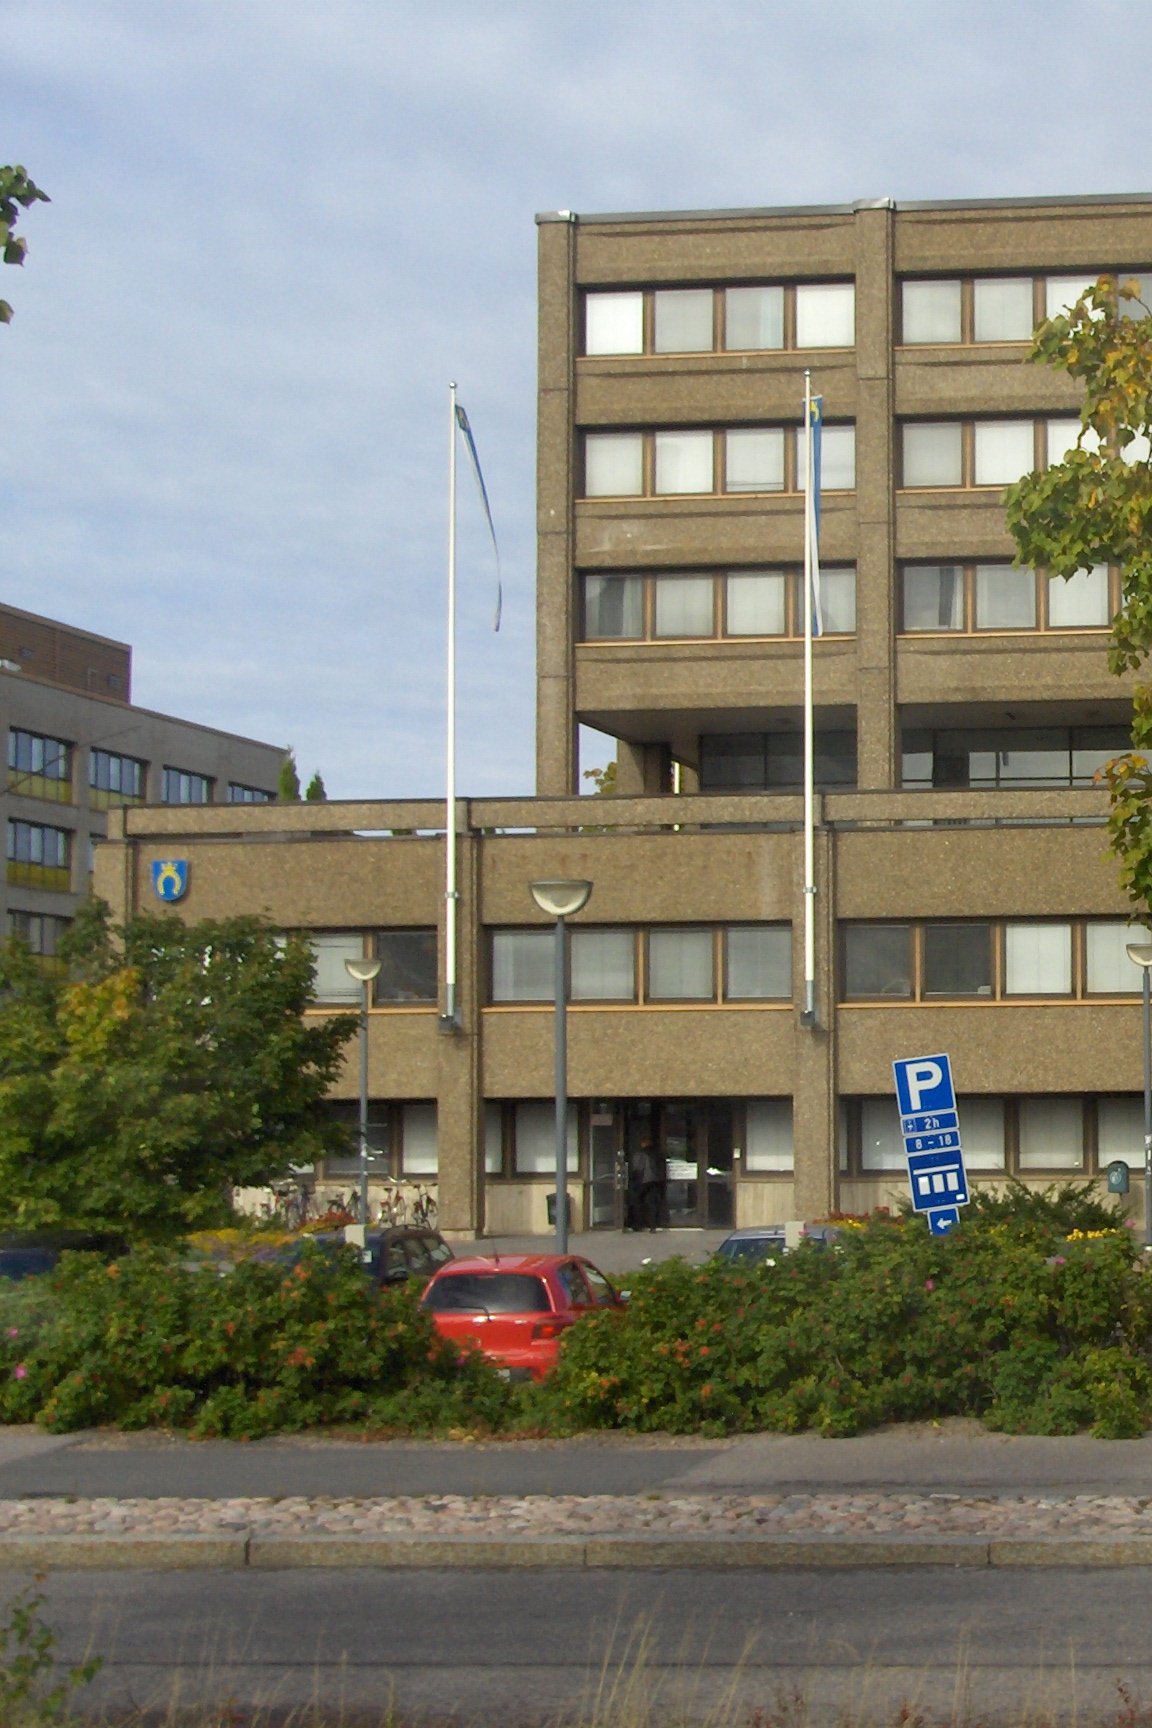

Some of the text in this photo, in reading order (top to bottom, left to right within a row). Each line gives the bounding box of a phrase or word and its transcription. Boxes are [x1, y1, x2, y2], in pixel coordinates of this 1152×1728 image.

[906, 1061, 943, 1111] P
[924, 1118, 940, 1130] 2h
[939, 1134, 952, 1146] 18
